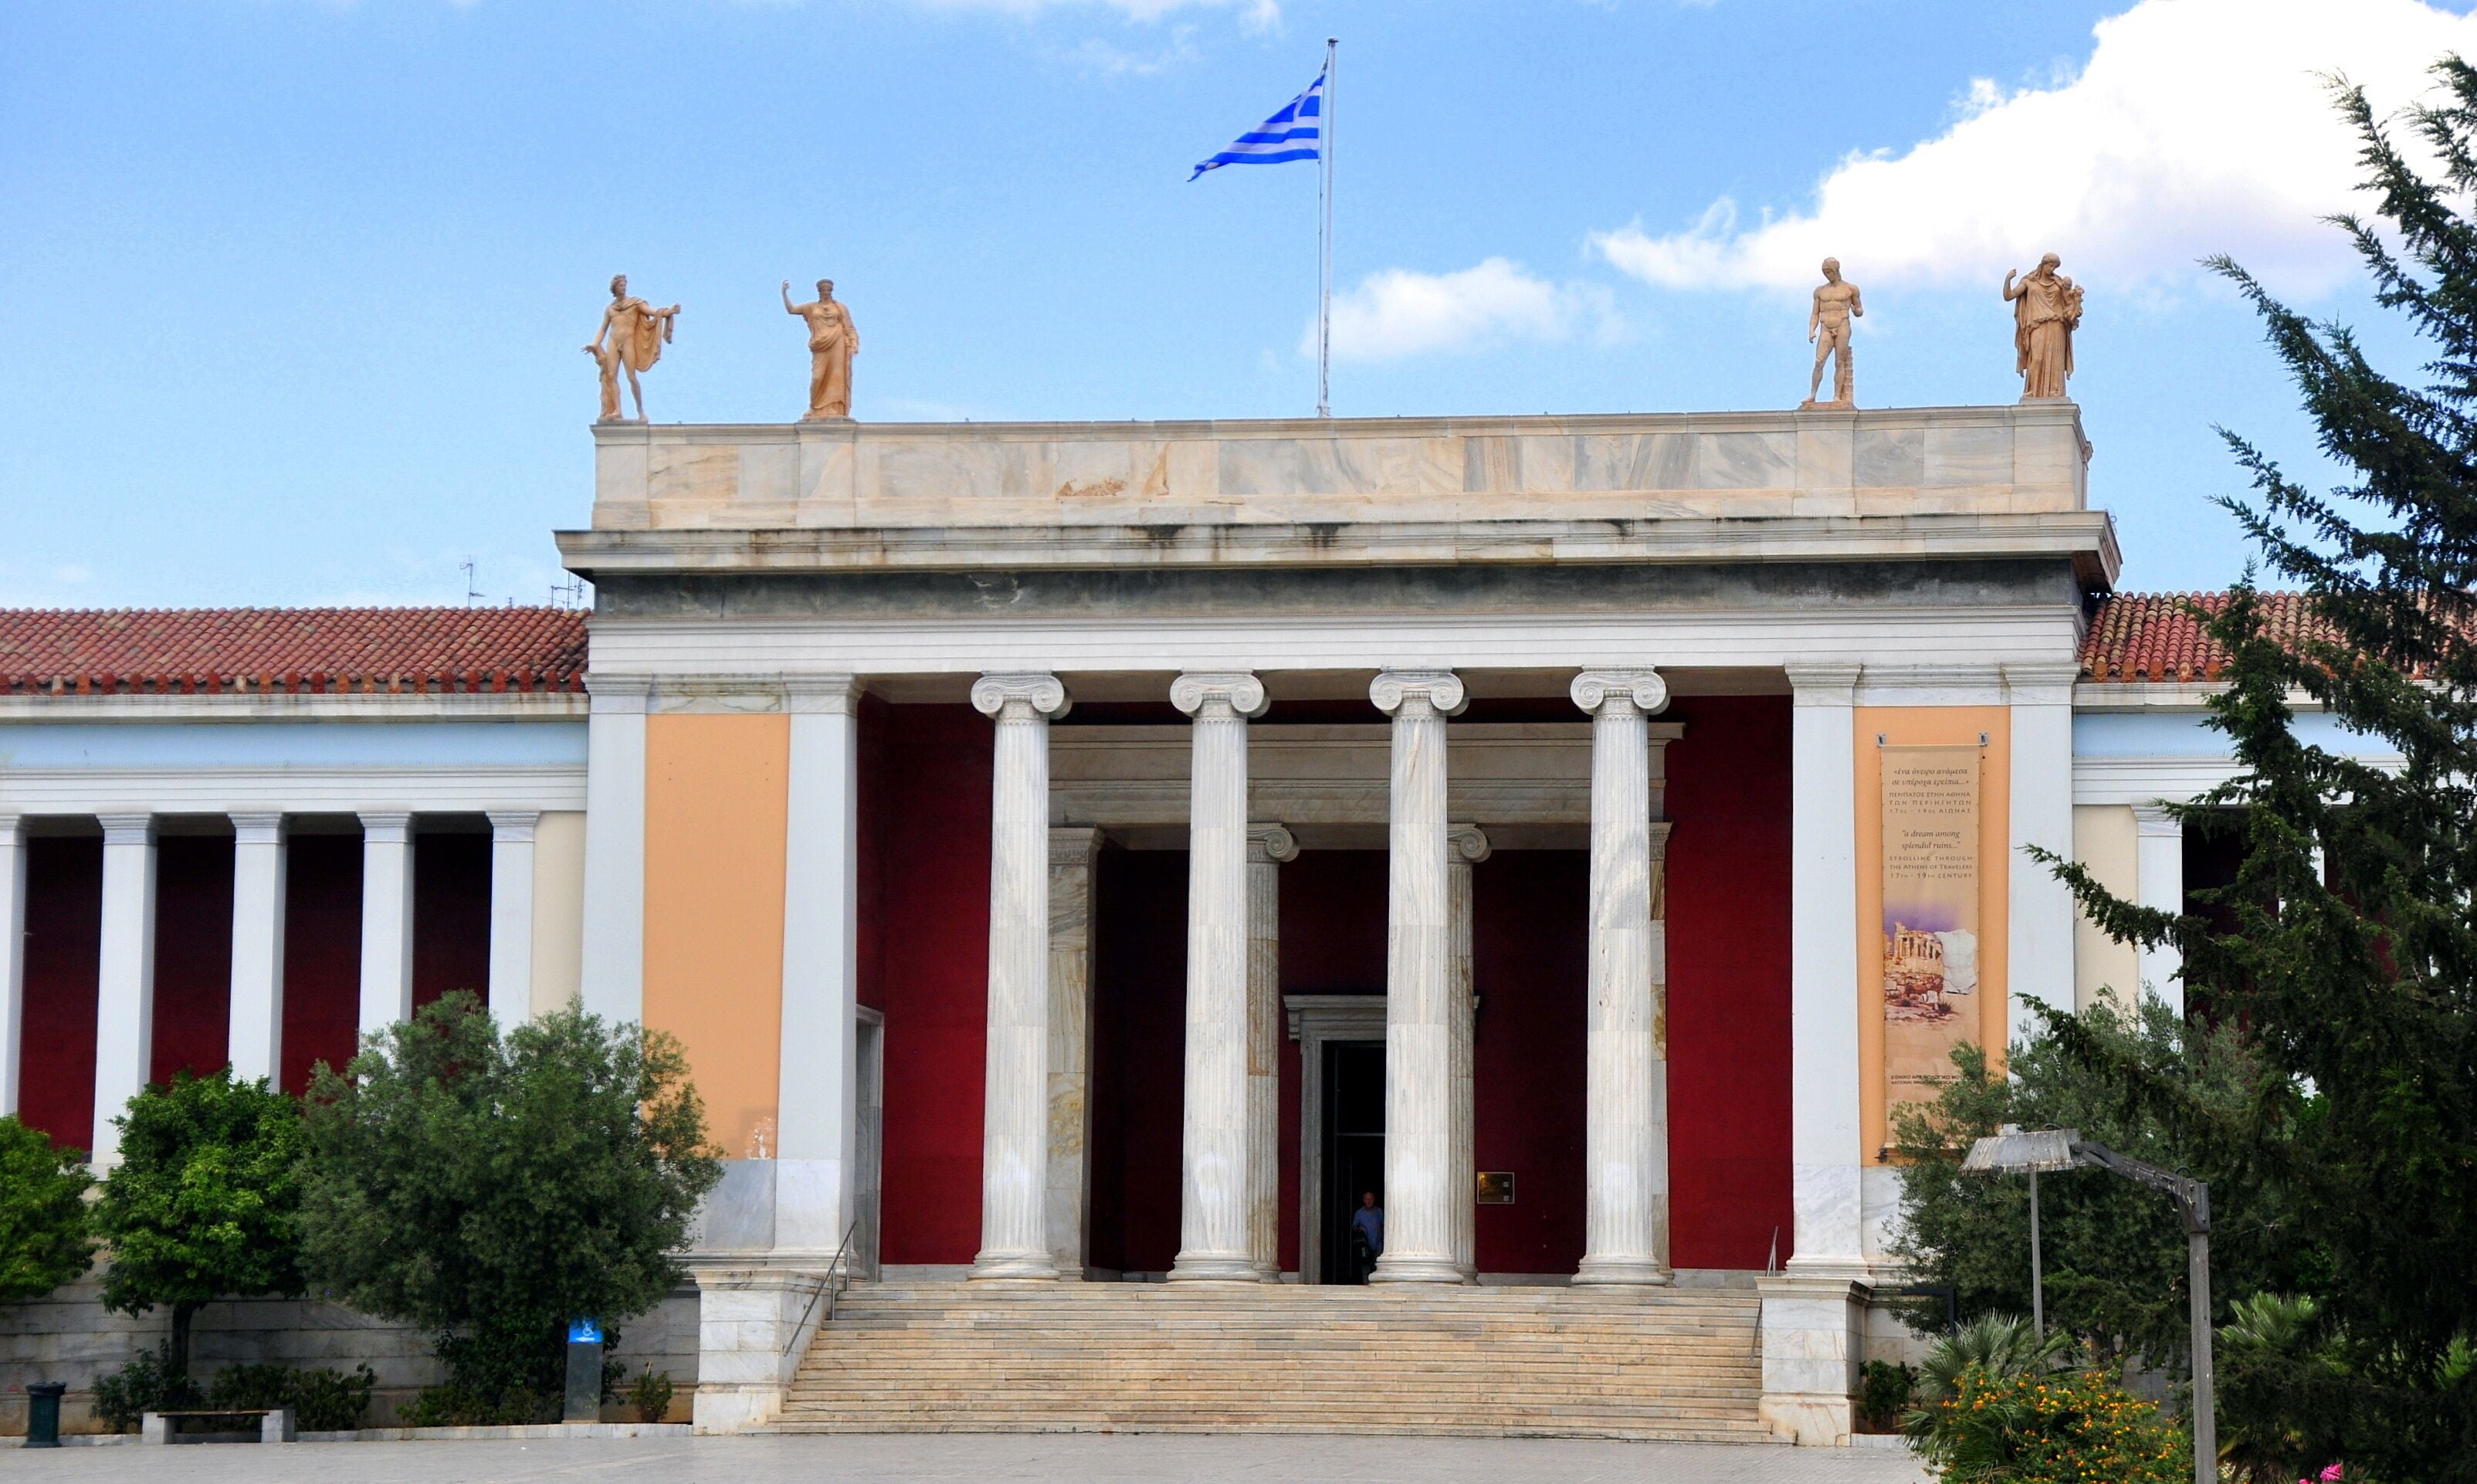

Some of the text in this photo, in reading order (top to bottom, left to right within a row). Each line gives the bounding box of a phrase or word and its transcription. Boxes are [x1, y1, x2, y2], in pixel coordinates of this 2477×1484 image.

[1902, 779, 1932, 788] υπέροχα
[1935, 830, 1960, 839] among
[1901, 842, 1931, 851] splendid
